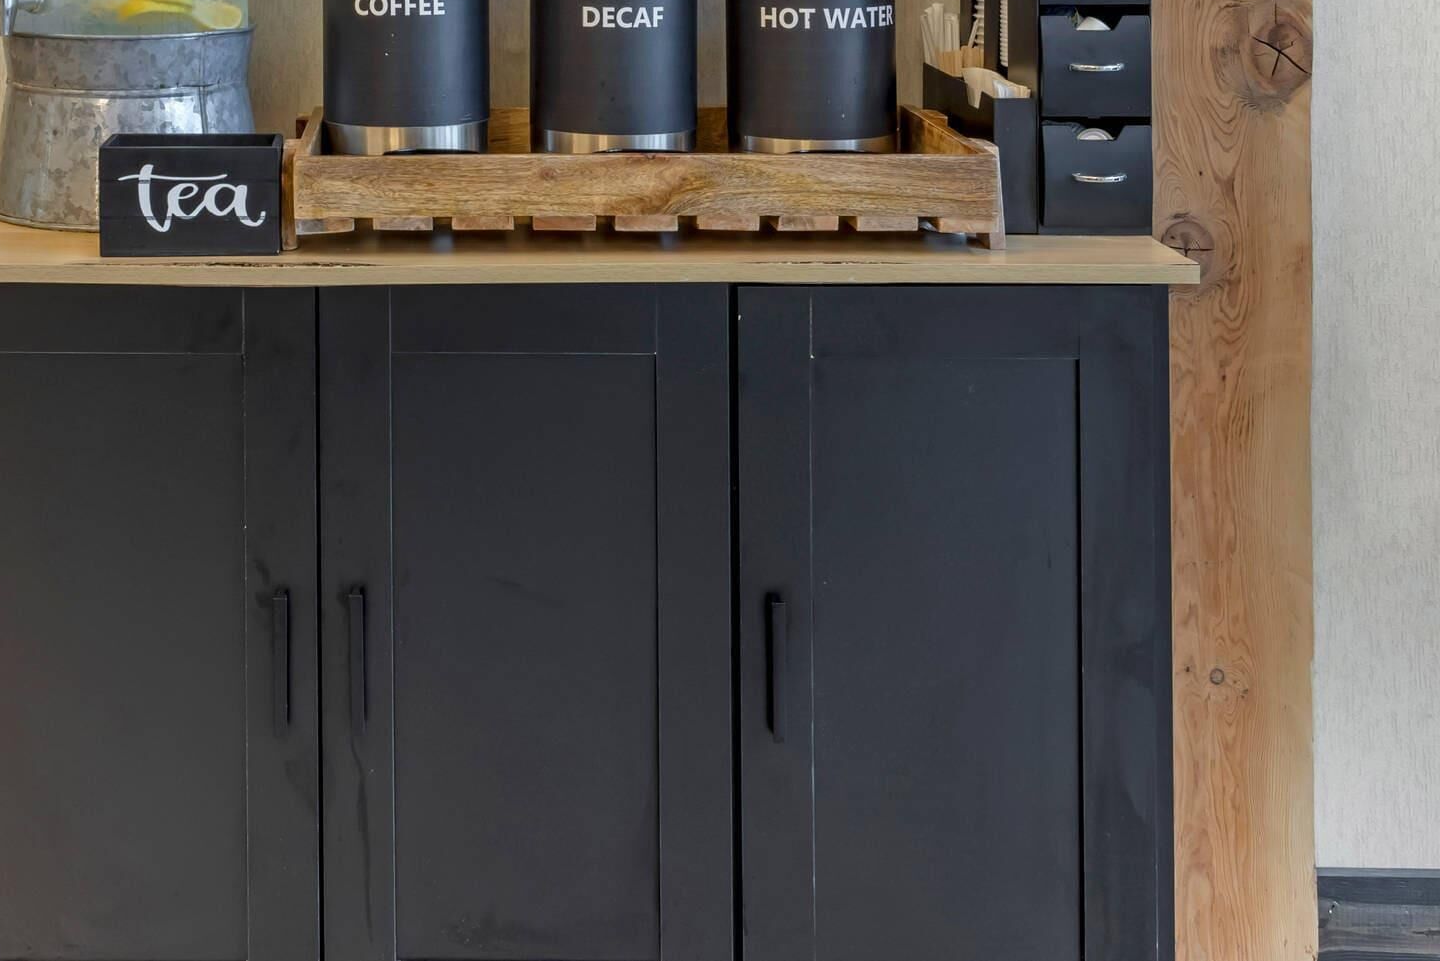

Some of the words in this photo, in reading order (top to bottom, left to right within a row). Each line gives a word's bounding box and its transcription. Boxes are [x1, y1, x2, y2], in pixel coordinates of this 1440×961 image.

[582, 6, 664, 28] DECAF
[760, 6, 816, 29] HOT
[823, 5, 894, 29] WATER
[118, 164, 266, 232] tea
